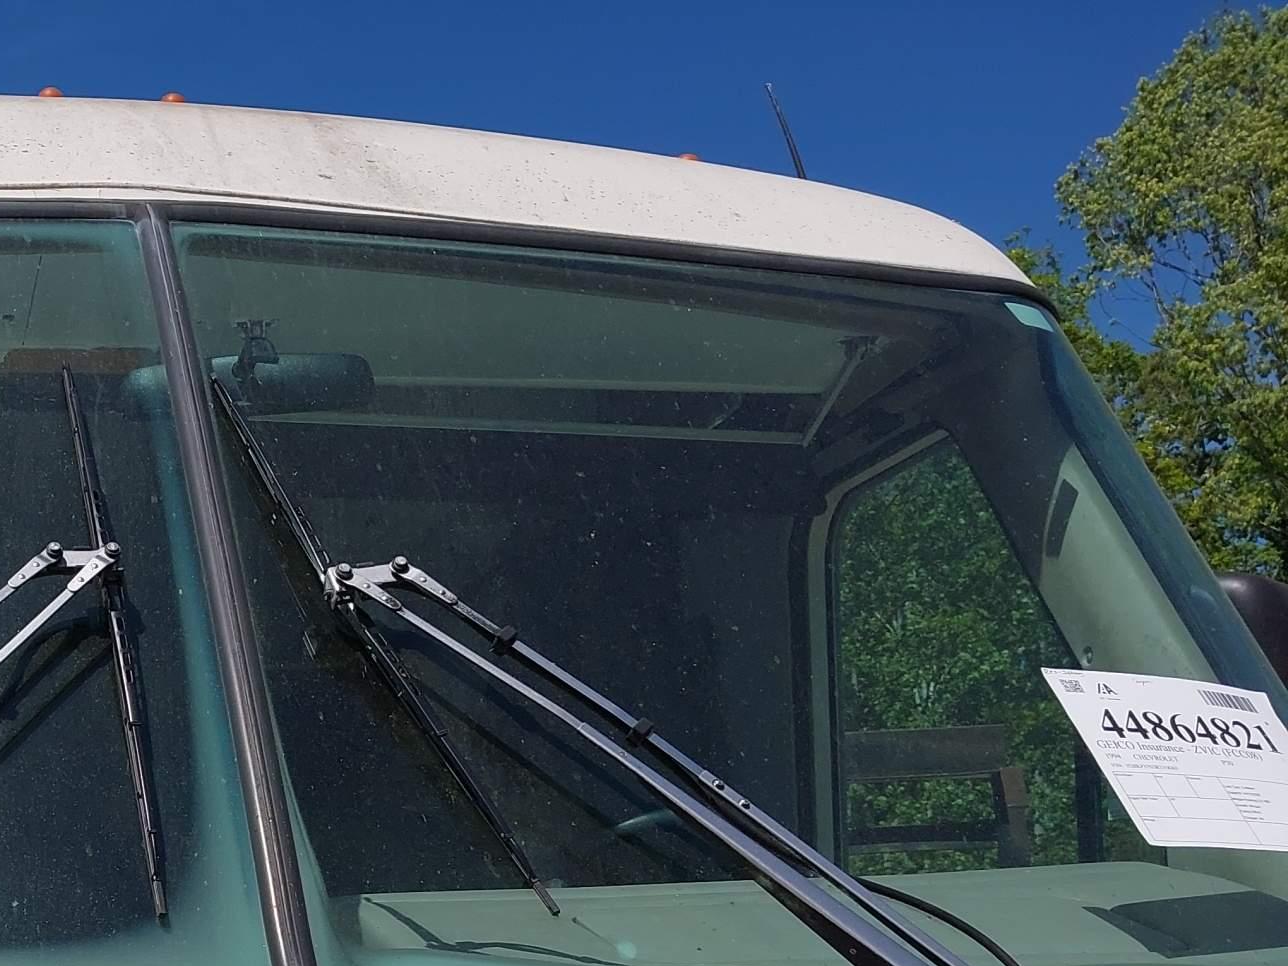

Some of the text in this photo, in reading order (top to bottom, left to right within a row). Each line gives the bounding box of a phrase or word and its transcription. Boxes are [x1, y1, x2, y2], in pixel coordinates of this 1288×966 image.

[1101, 708, 1283, 754] 44864821
[1096, 740, 1135, 750] GEICO
[1136, 742, 1185, 752] Insurance
